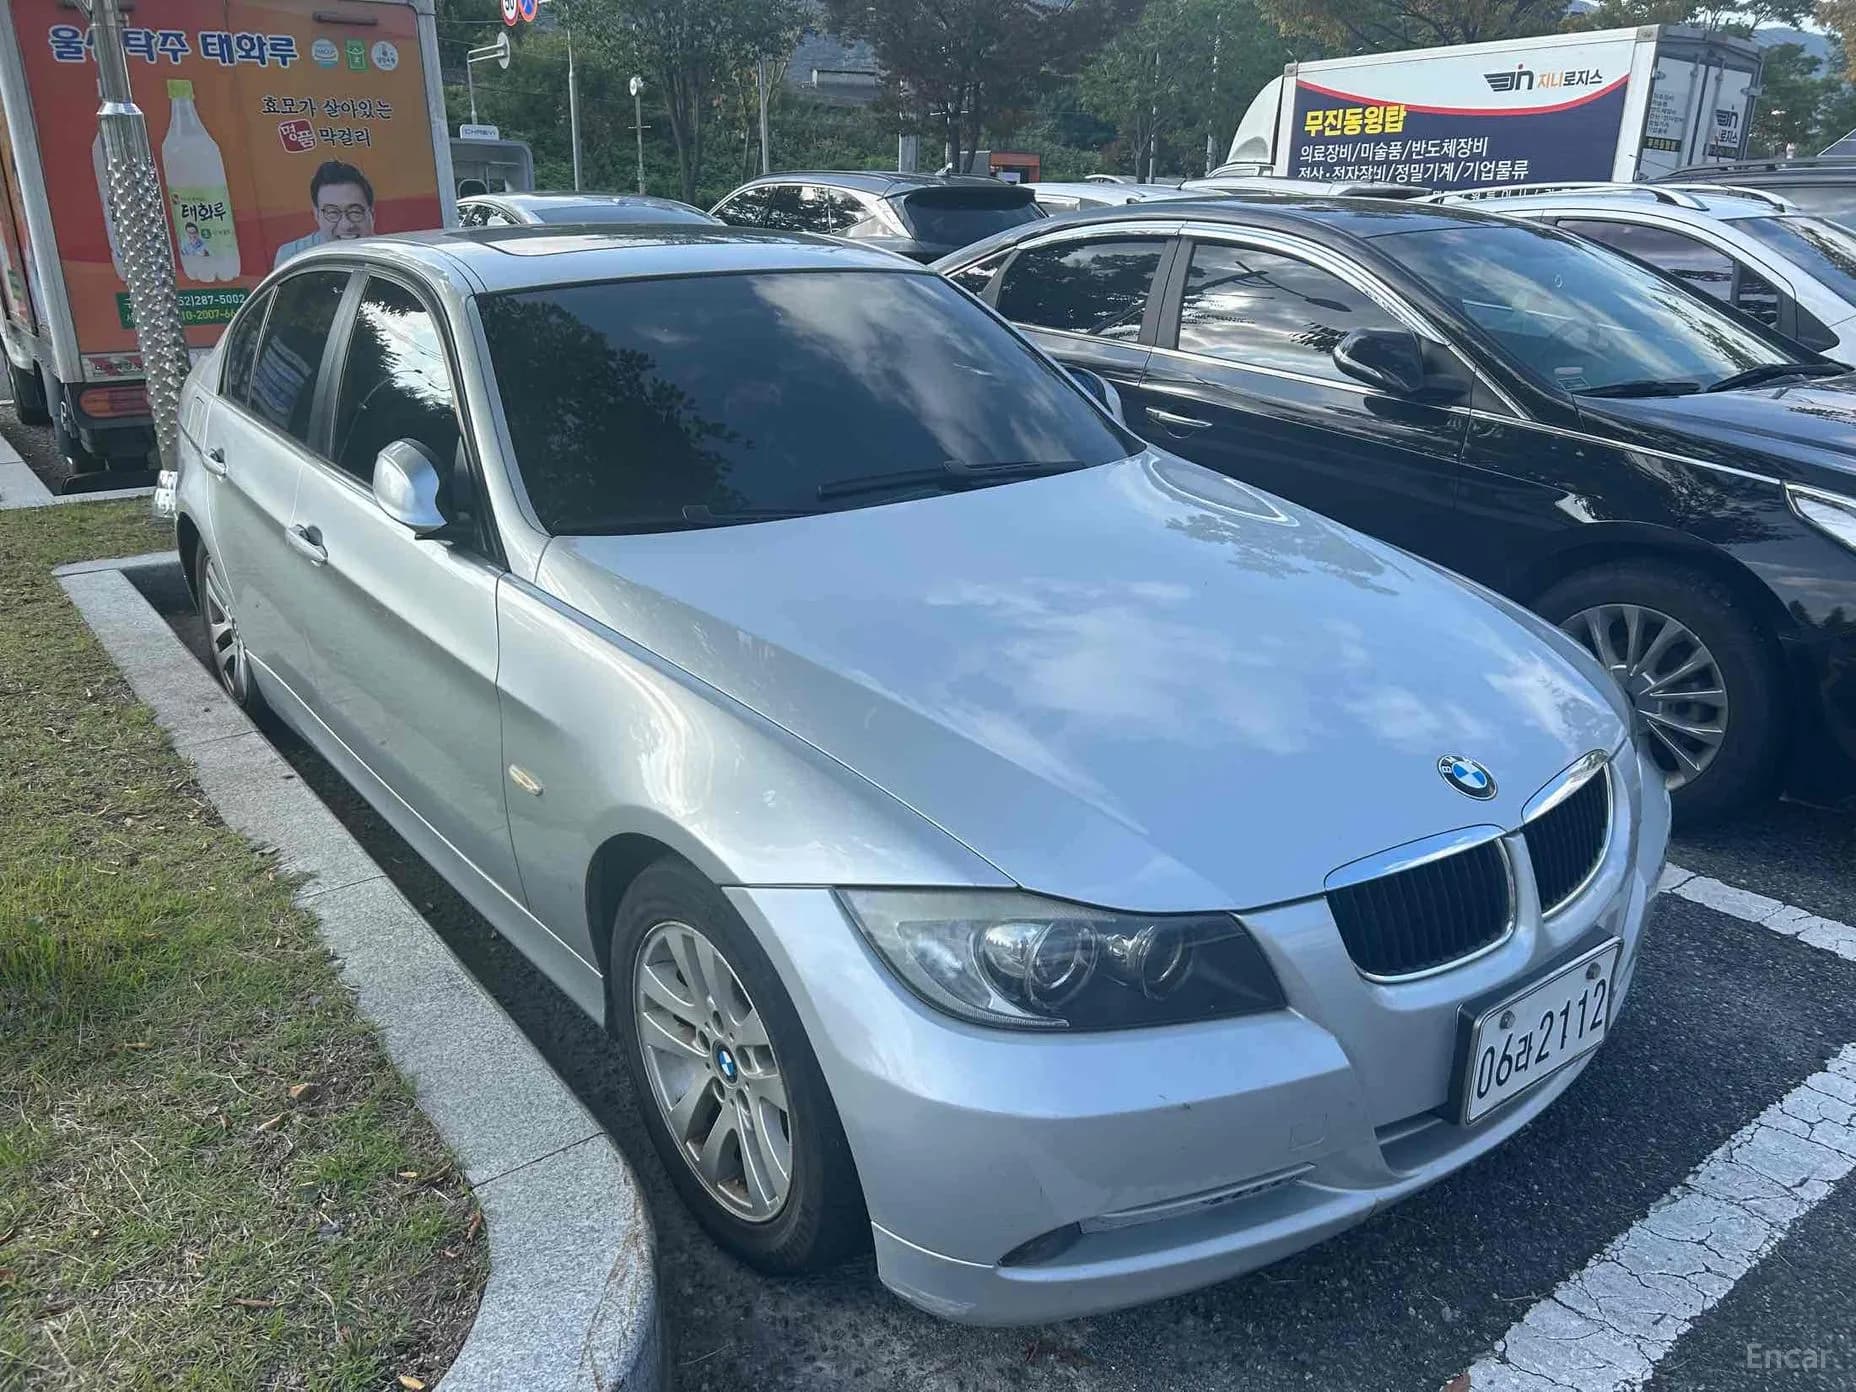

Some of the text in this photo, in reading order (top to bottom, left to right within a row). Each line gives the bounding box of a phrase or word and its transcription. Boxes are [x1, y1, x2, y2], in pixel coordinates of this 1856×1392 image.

[50, 26, 298, 66] 울탁주 태화루
[1538, 69, 1603, 89] 지니로지스
[262, 96, 392, 119] 효모가 살아있는
[1304, 105, 1407, 136] 무진동윙탑
[280, 122, 371, 149] 명품 막걸리
[181, 202, 226, 221] 태화루
[1477, 979, 1606, 1099] 06라2112
